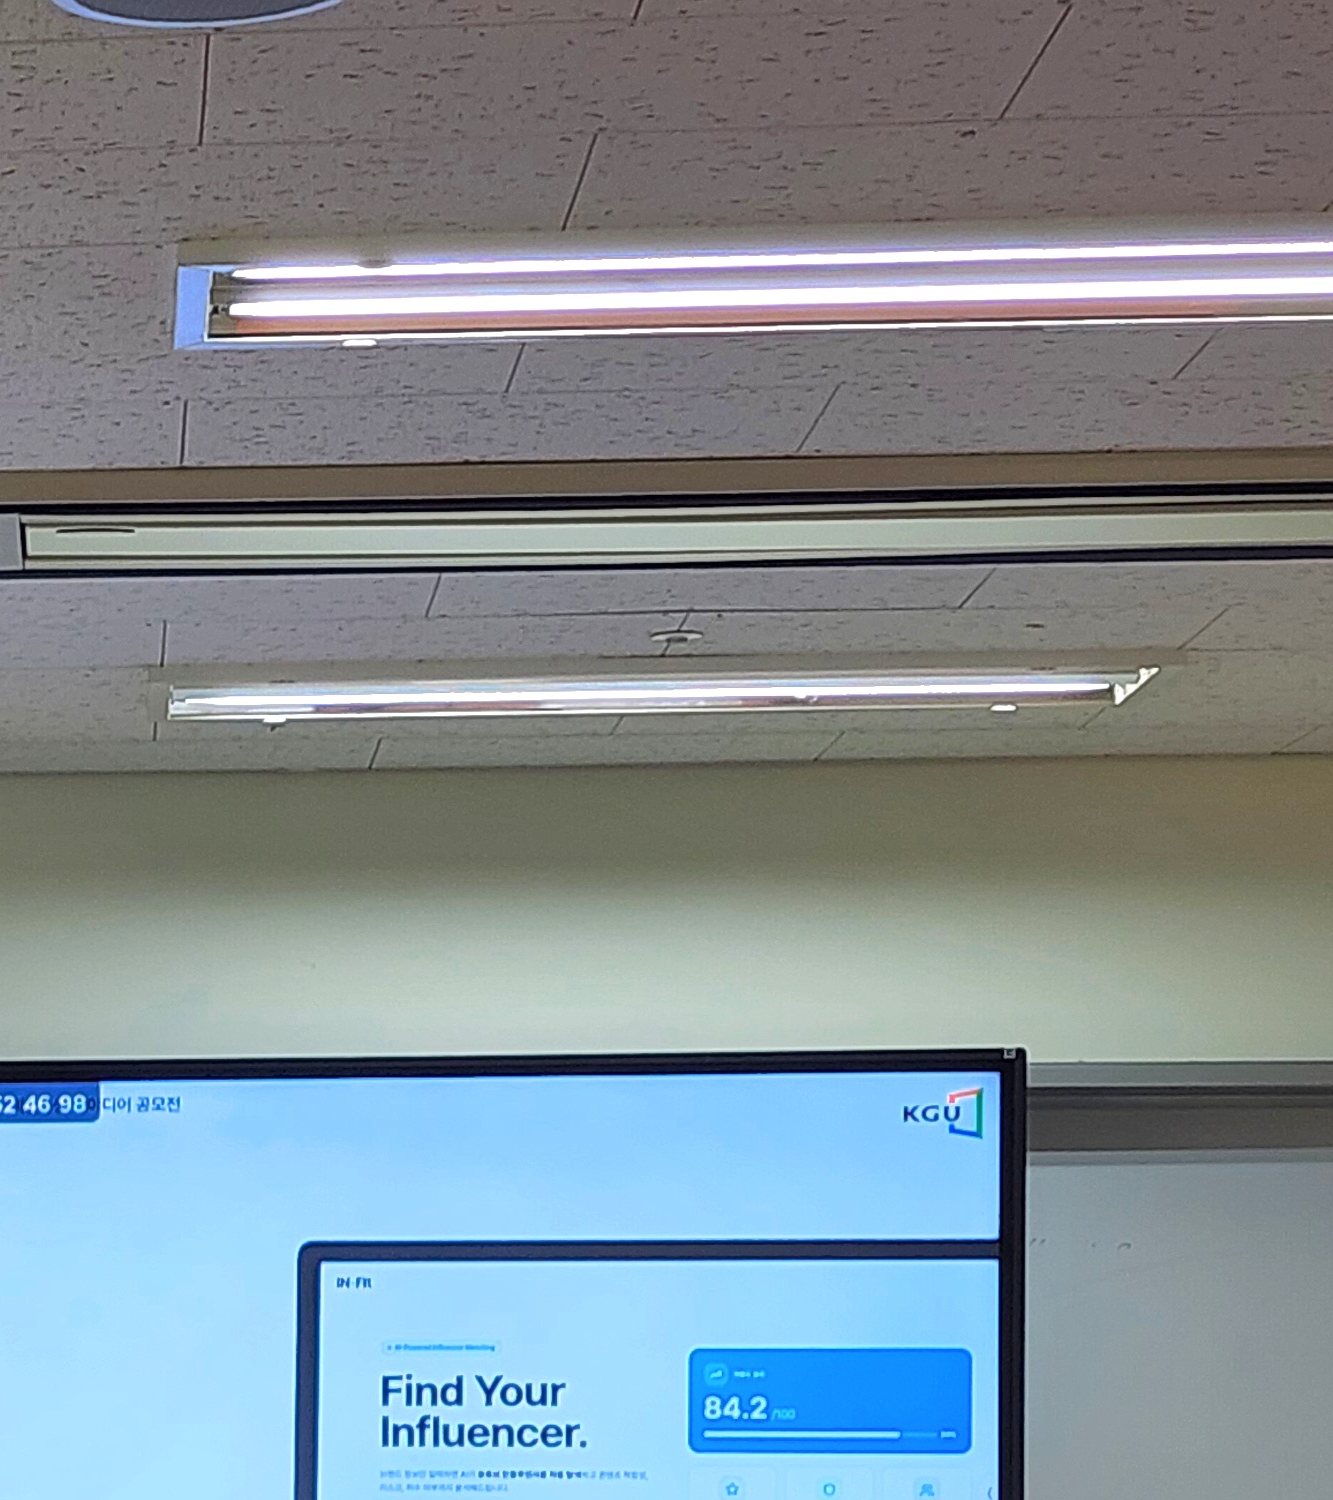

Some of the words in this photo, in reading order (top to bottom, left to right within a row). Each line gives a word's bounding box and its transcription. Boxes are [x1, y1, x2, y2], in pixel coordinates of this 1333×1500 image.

[23, 1094, 51, 1114] 46
[58, 1093, 86, 1114] 98
[136, 1096, 181, 1113] 공모전
[903, 1104, 961, 1123] KGU
[381, 1374, 464, 1407] Find
[474, 1374, 567, 1407] Your
[703, 1395, 768, 1421] 84.2
[381, 1414, 588, 1449] Influencer.
